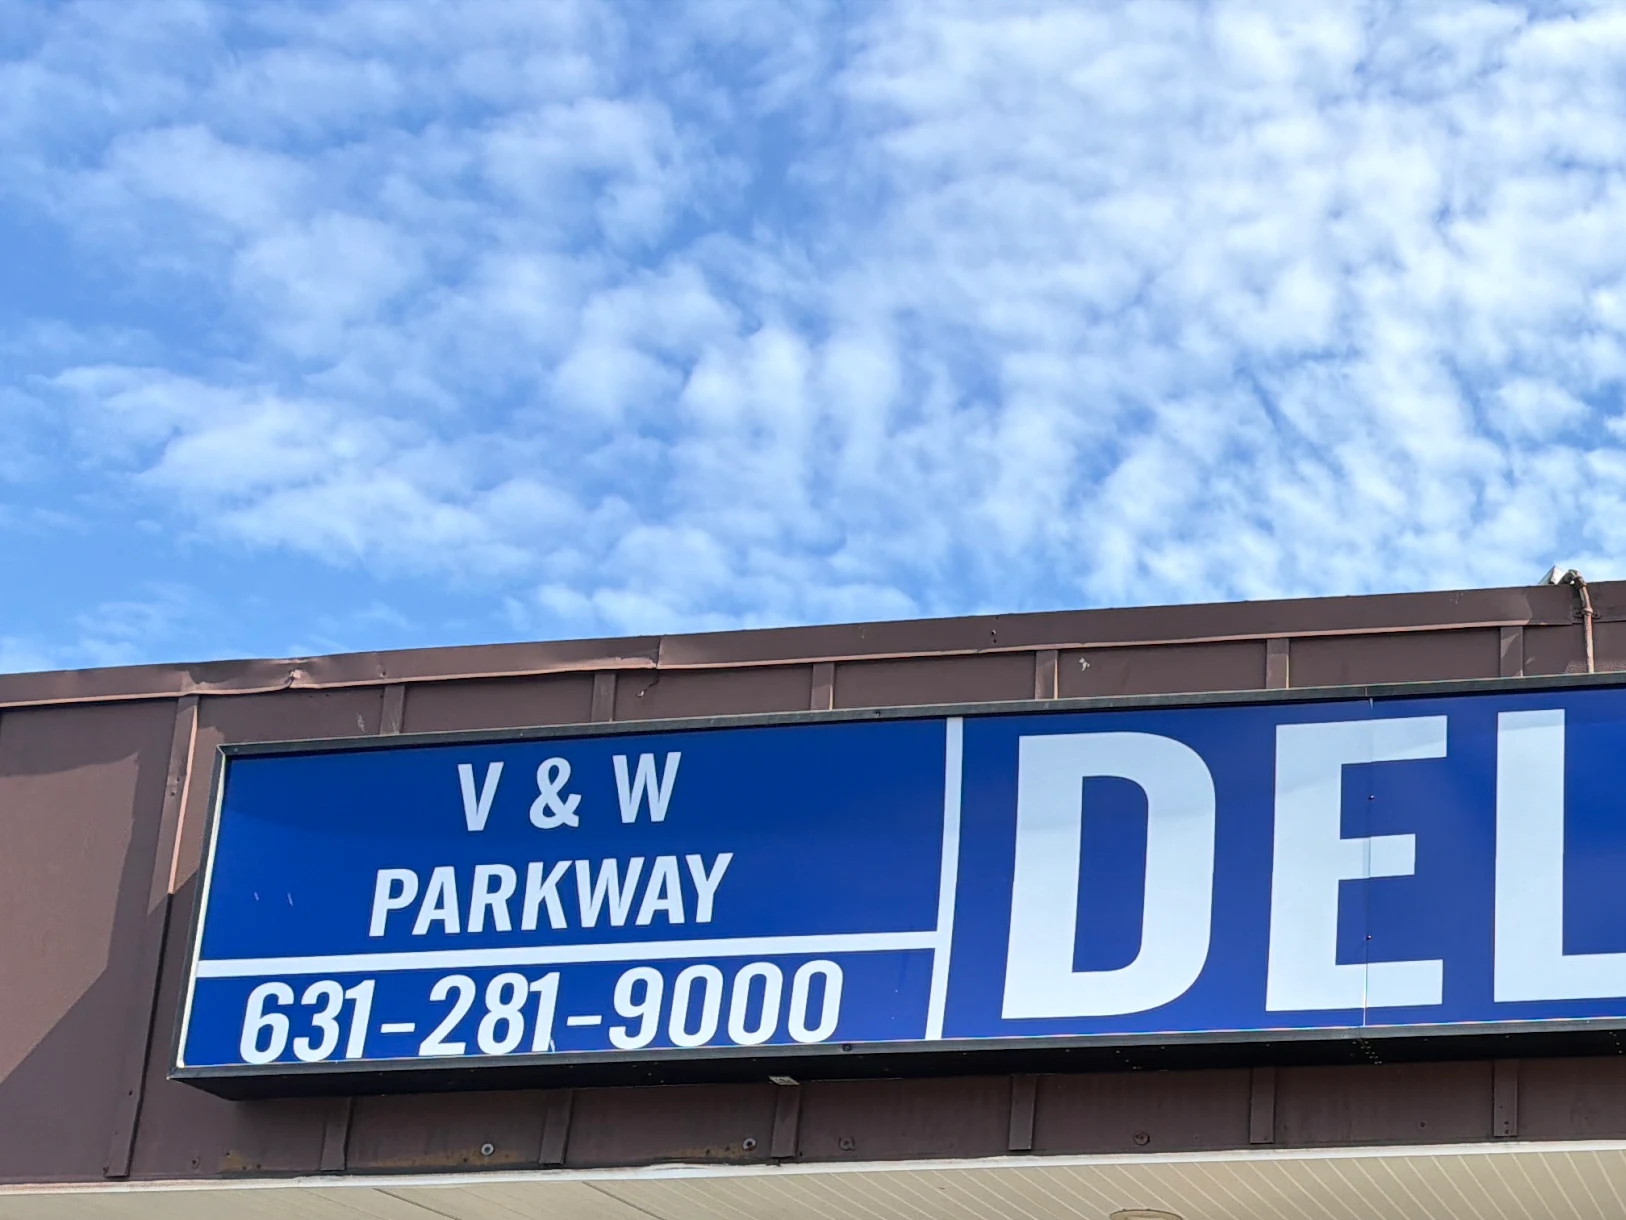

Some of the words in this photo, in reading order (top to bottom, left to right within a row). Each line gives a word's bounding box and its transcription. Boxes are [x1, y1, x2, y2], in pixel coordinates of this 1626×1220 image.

[458, 762, 504, 832] V
[529, 757, 582, 829] &
[612, 752, 682, 824] W
[368, 852, 734, 937] PARKWAY
[239, 959, 844, 1065] 631-281-9000
